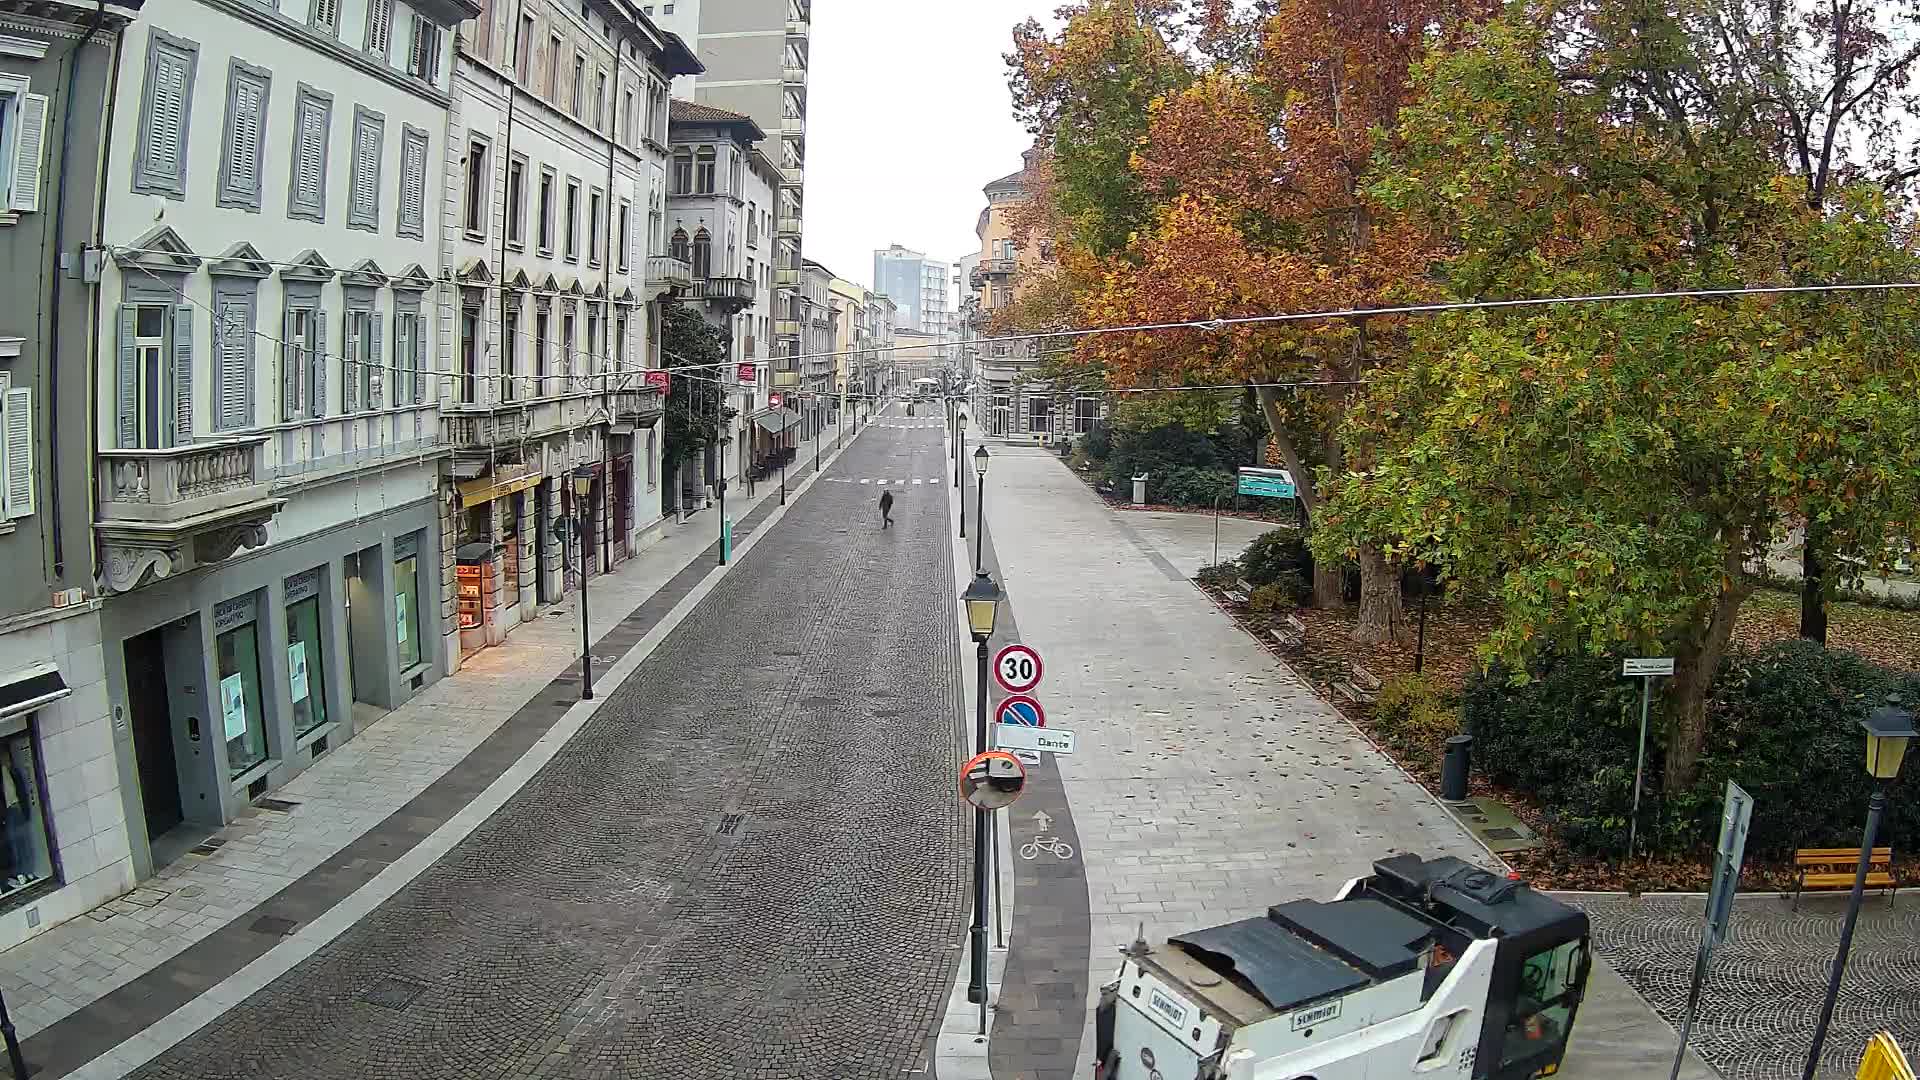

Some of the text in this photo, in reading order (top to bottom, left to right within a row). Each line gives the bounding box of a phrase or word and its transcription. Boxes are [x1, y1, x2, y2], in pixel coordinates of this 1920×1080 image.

[1005, 658, 1032, 680] 30
[1038, 737, 1069, 749] Dante
[1152, 994, 1184, 1022] SCHMIDT
[1296, 1005, 1338, 1026] SCHMIDT
